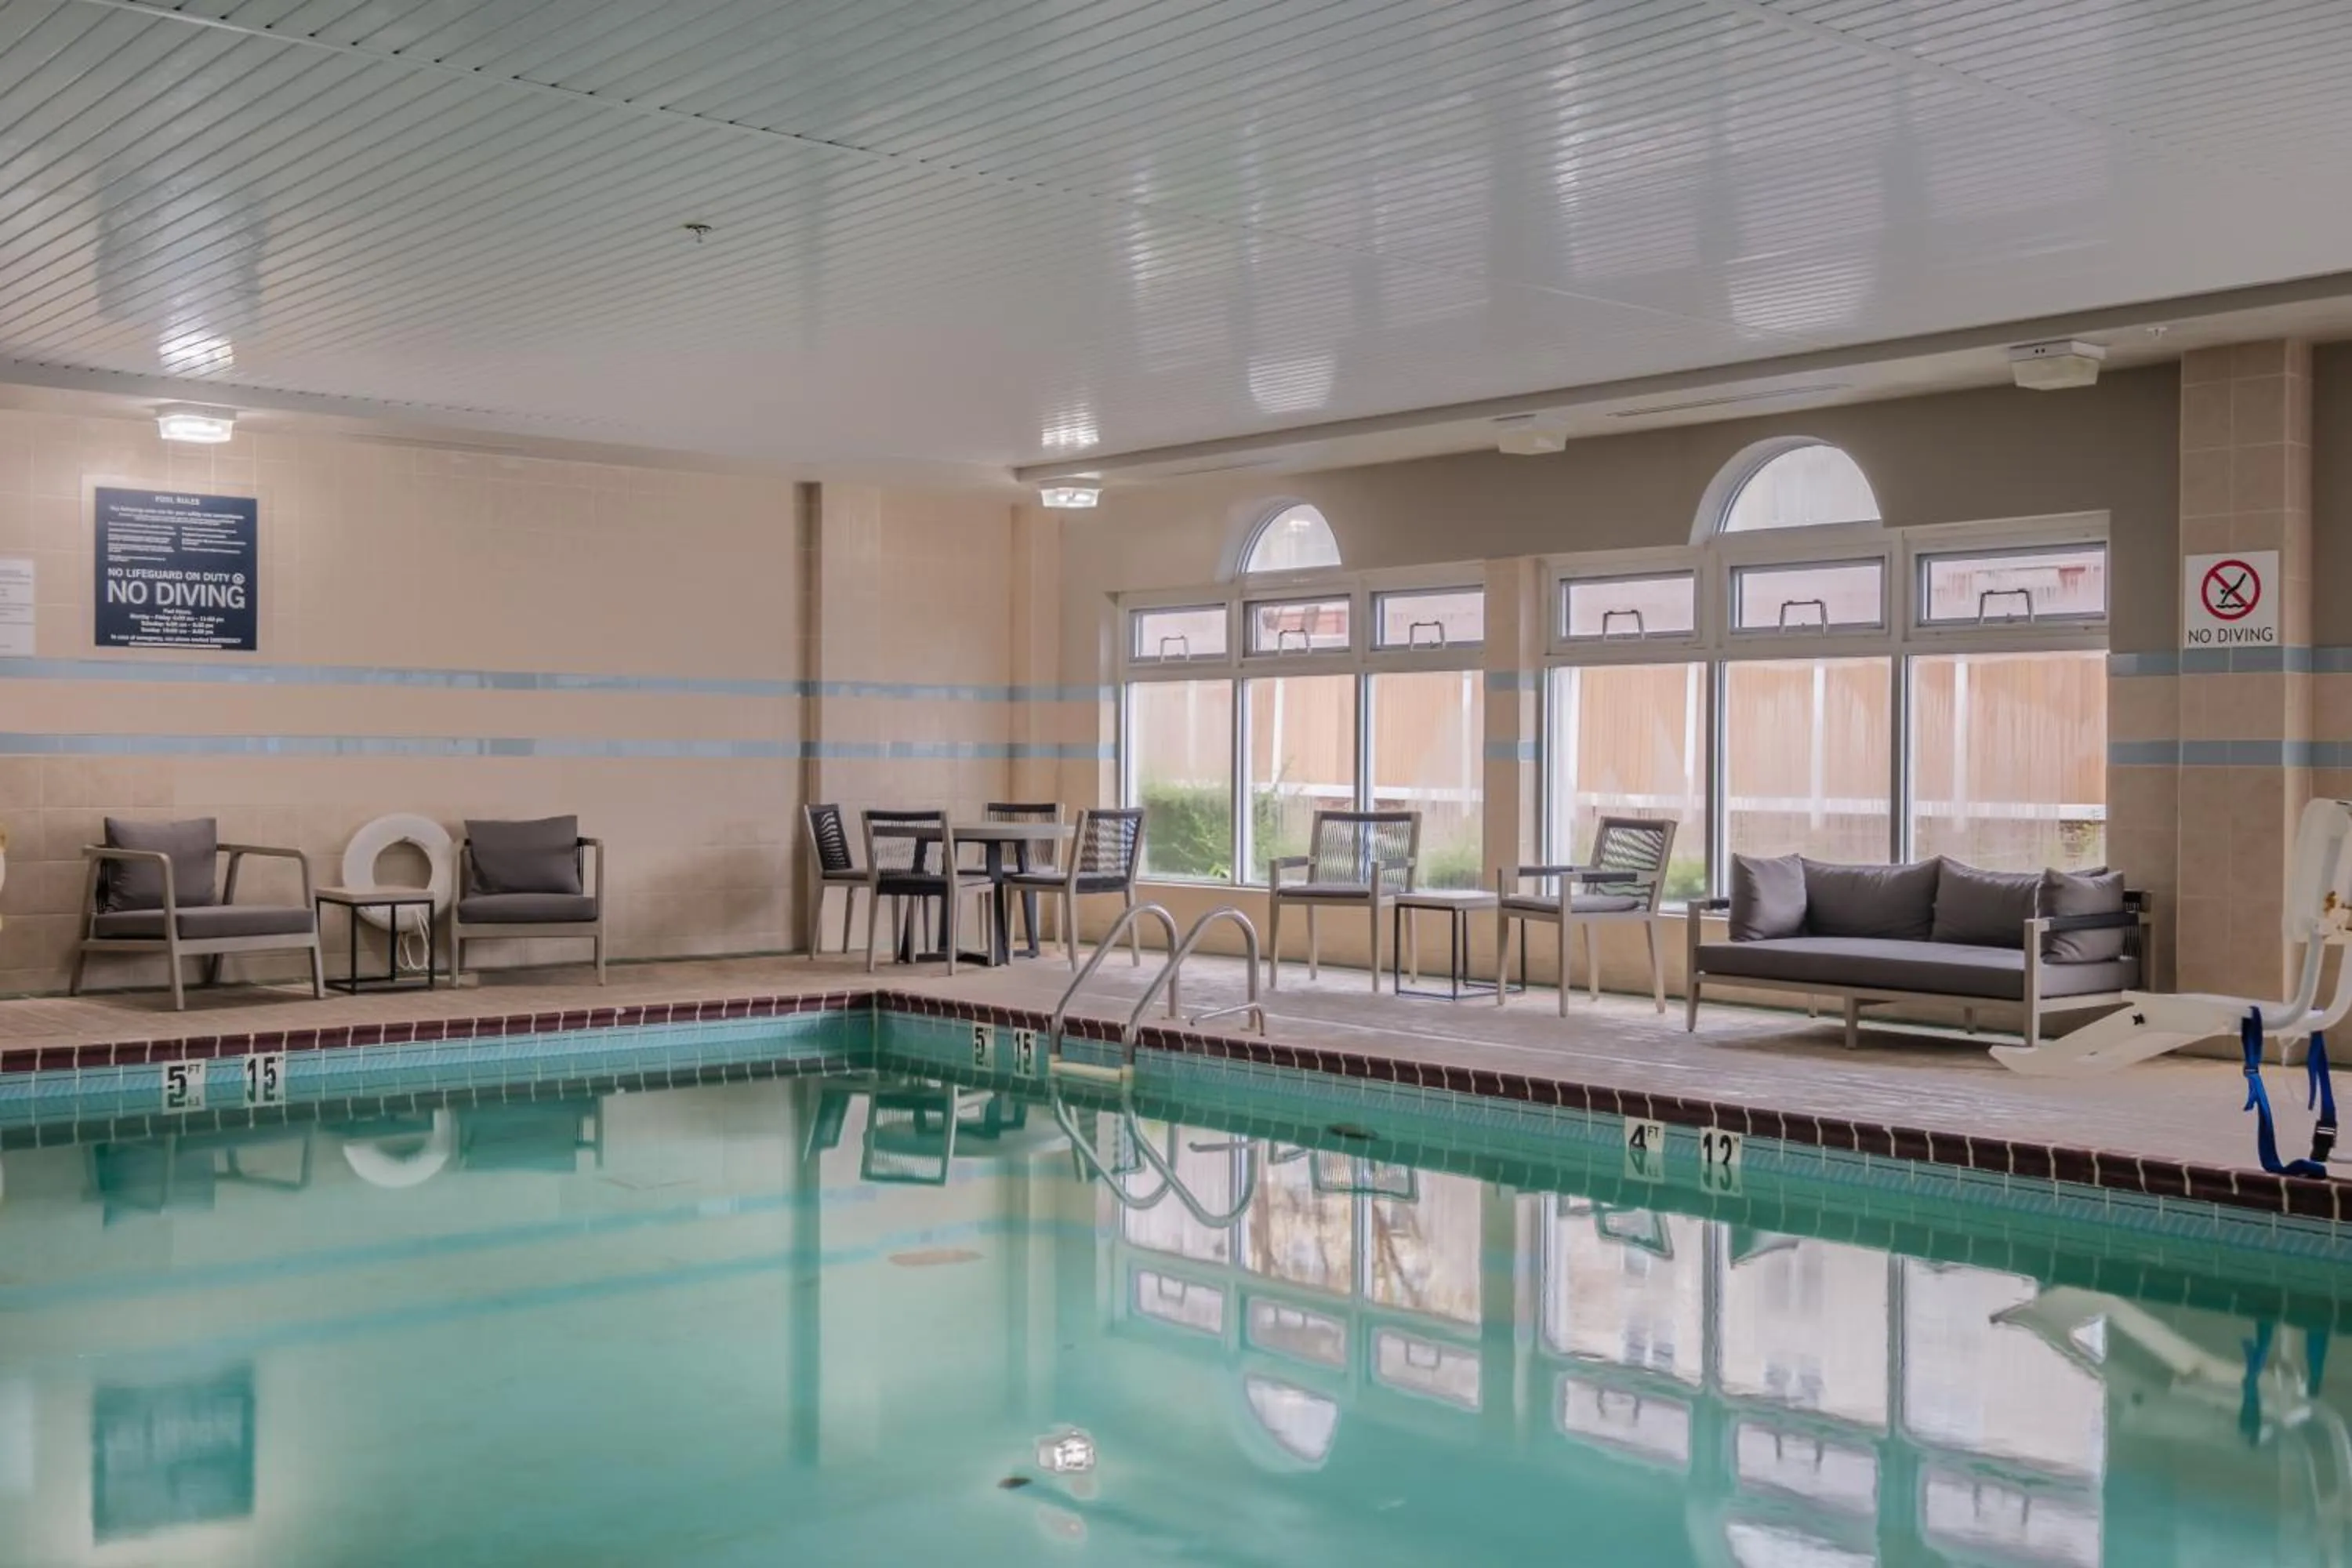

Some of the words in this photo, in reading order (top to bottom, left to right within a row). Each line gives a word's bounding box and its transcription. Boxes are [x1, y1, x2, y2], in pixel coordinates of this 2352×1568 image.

[107, 568, 123, 577] NO
[125, 568, 183, 580] LIFEGUARD
[185, 572, 201, 581] ON
[203, 572, 230, 583] DUTY
[107, 579, 148, 604] NO
[154, 581, 245, 609] DIVING
[2188, 629, 2212, 644] NO
[2218, 627, 2273, 643] DIVING
[168, 1065, 187, 1089] 5
[187, 1064, 201, 1074] FT
[1629, 1124, 1646, 1151] 4
[1647, 1126, 1660, 1138] FT
